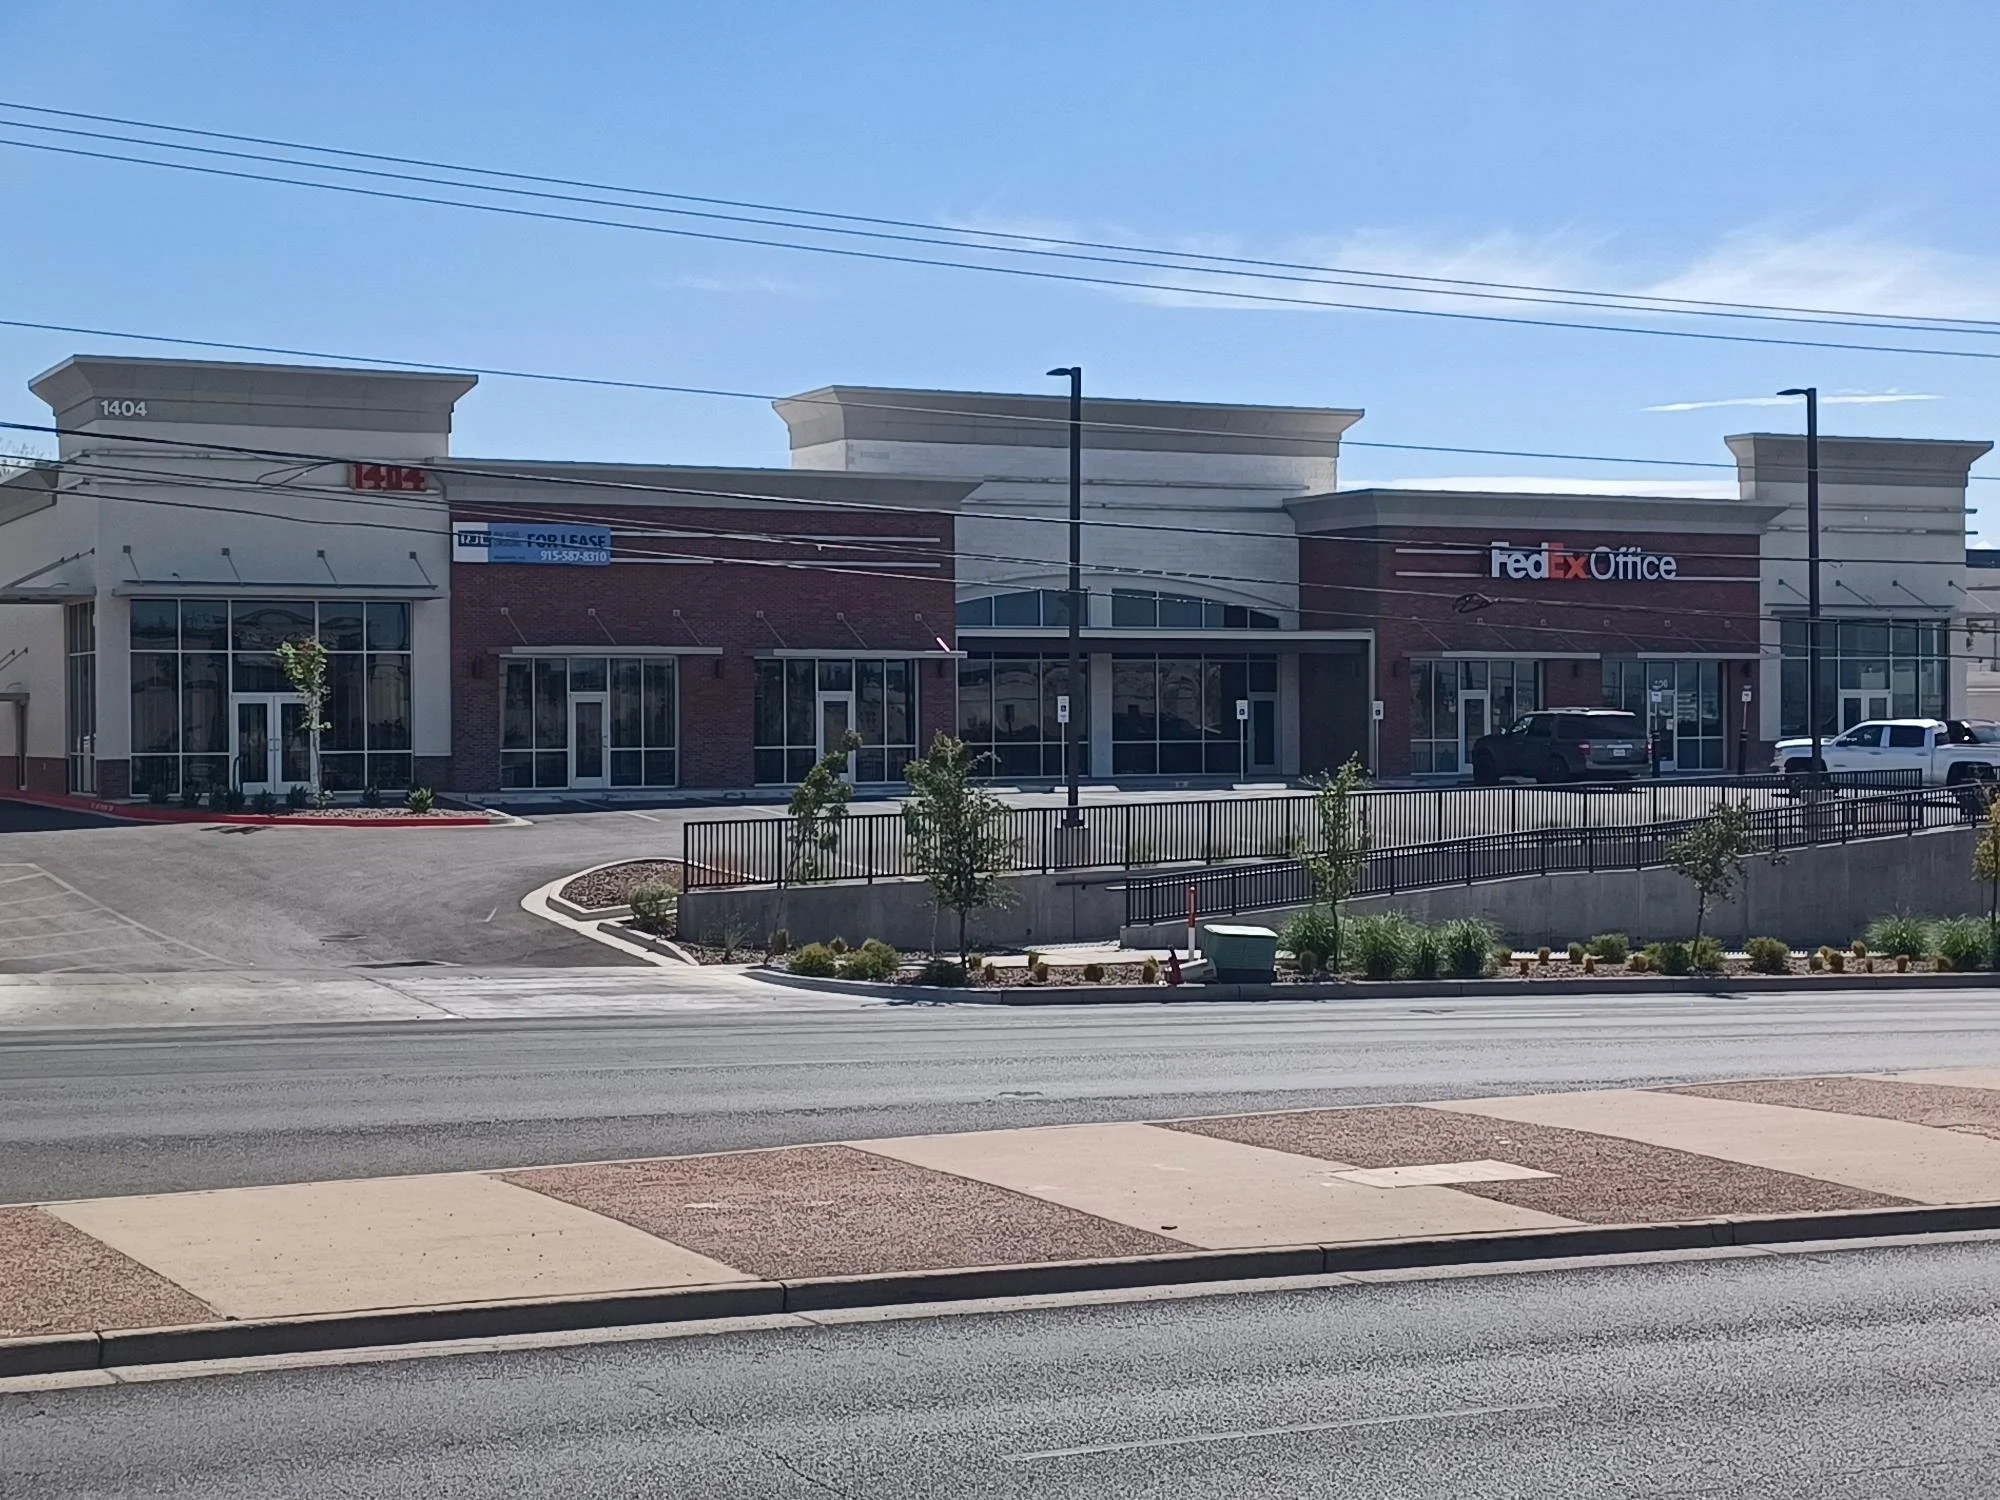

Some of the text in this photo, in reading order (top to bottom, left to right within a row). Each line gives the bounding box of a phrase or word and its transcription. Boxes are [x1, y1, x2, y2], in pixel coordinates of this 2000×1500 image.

[101, 400, 147, 416] 1404
[355, 463, 425, 491] 1404
[527, 534, 557, 548] FOR
[560, 534, 606, 549] LEASE
[540, 550, 607, 562] 915-587-8310
[1491, 541, 1677, 580] FedEx Office
